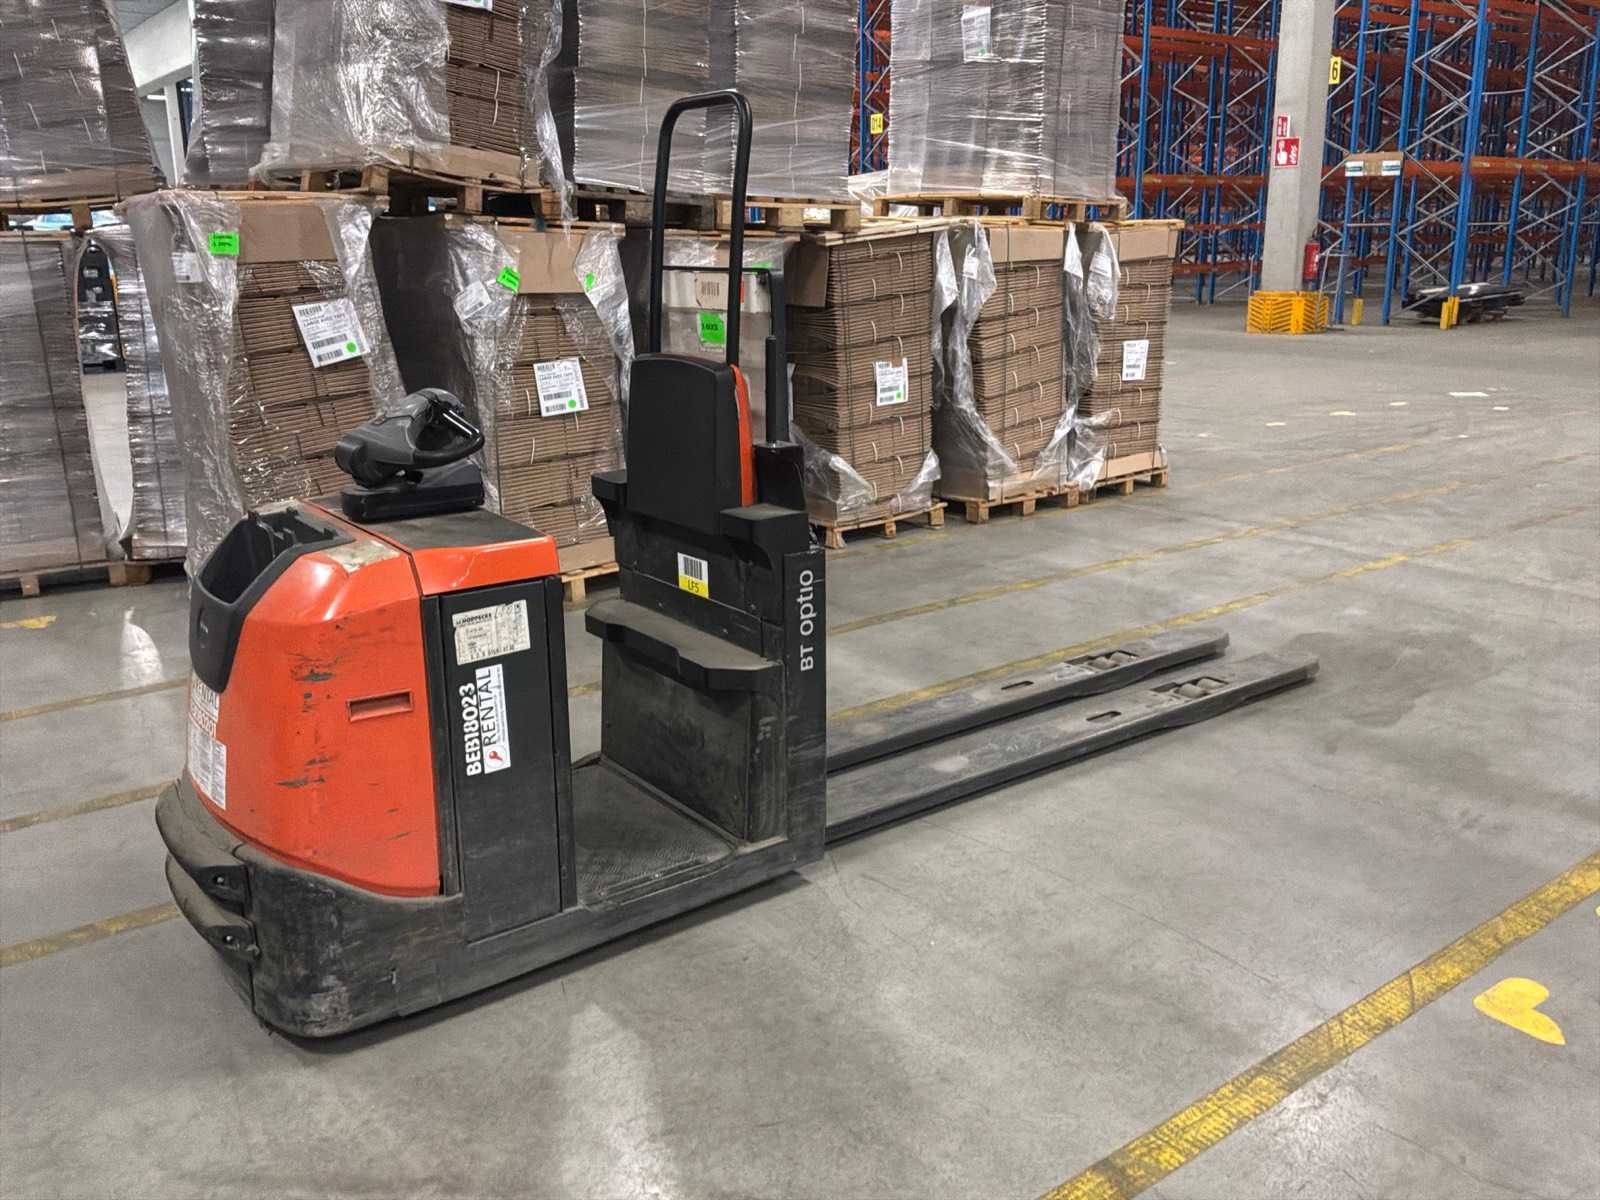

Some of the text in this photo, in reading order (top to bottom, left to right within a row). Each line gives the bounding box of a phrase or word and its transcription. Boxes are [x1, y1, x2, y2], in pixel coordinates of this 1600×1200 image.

[1332, 61, 1339, 80] 6
[796, 570, 817, 672] BT optio
[458, 682, 482, 776] BEB18023
[476, 668, 497, 747] RENTAL
